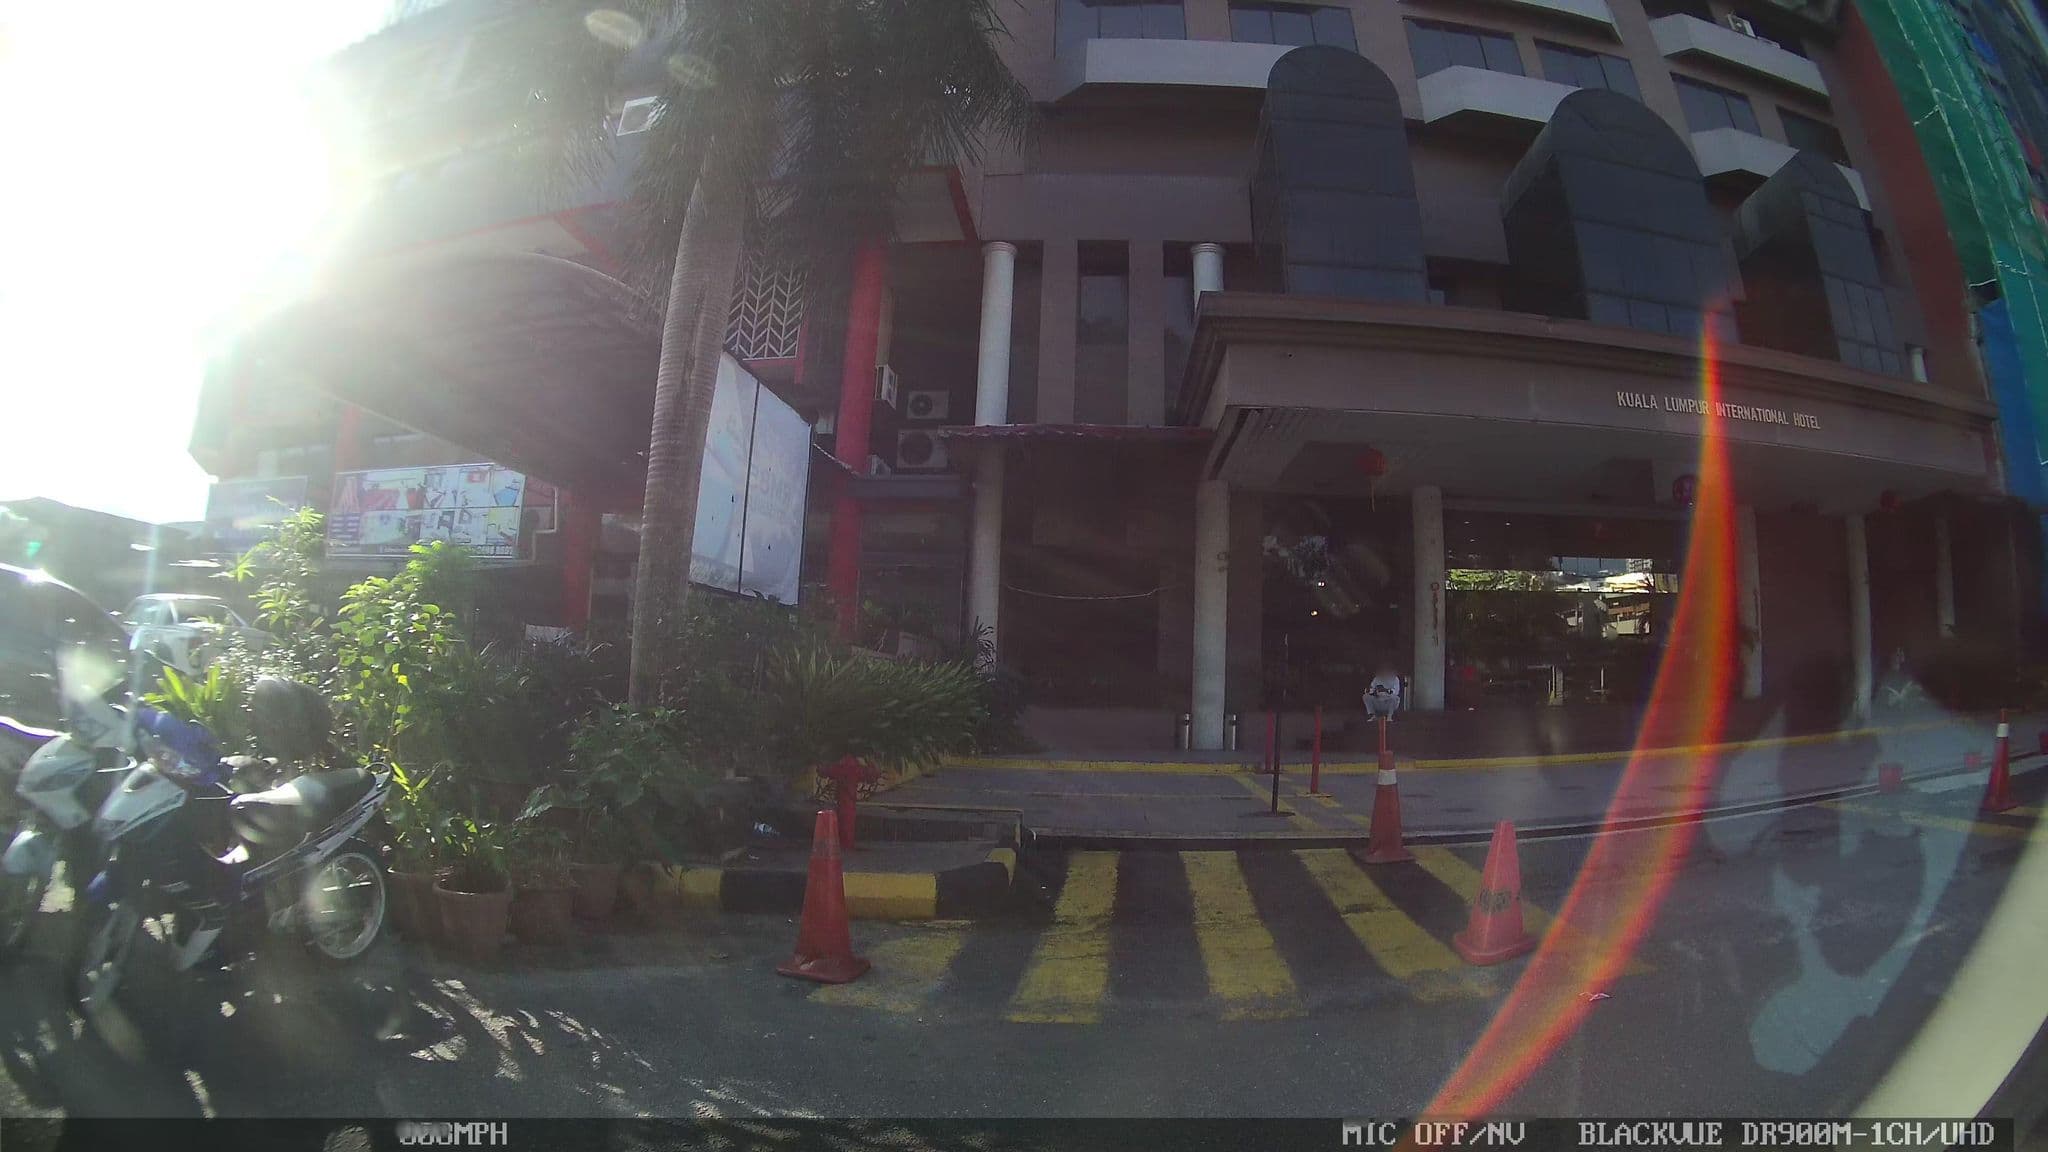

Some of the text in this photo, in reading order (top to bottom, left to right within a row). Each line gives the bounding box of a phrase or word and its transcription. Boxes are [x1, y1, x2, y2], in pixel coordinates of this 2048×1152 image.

[1617, 391, 1821, 430] KUALA LUMPUR INTERNATIONAL HOTEL
